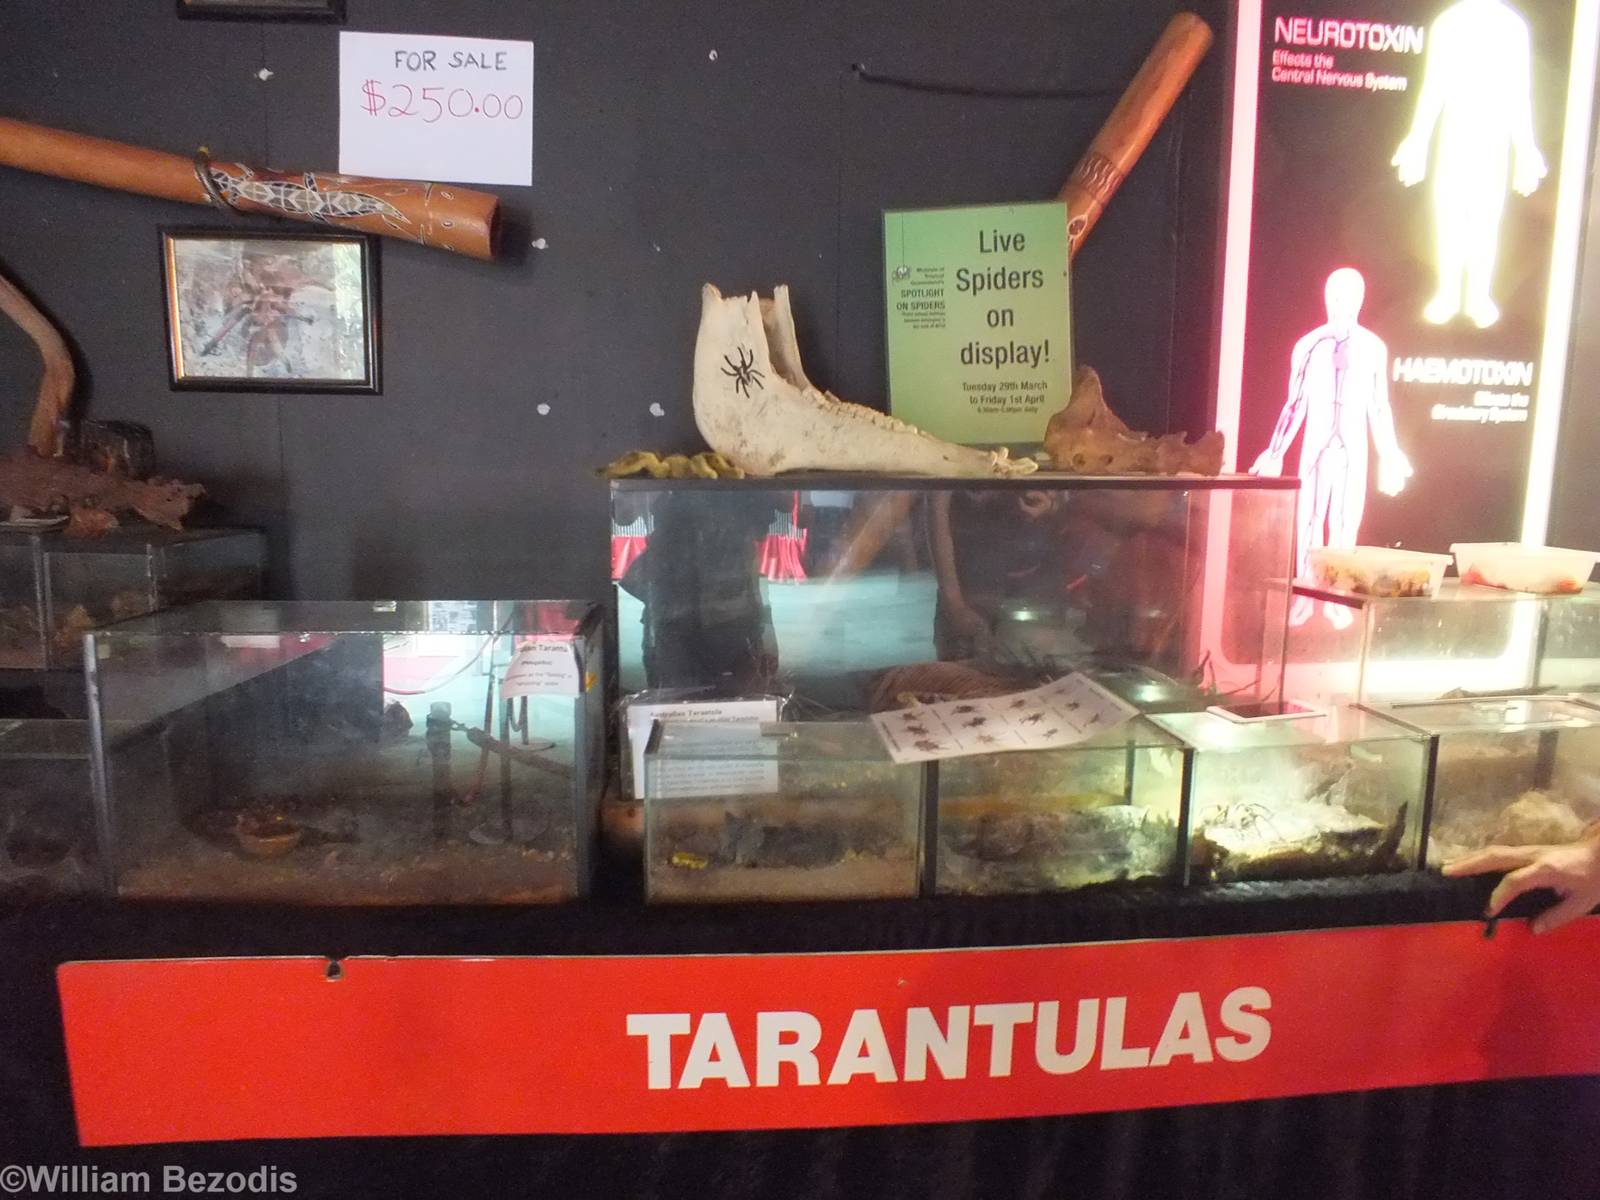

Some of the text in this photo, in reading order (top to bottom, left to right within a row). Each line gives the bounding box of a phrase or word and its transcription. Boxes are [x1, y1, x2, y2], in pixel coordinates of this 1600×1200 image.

[1274, 16, 1425, 54] NEUROTOXIN
[394, 50, 508, 71] FOR SALE
[1272, 49, 1335, 69] Effects the
[1271, 66, 1408, 92] Central Nervous System
[359, 79, 523, 123] $250.00
[979, 229, 1026, 254] Live
[900, 288, 945, 298] SPOTLIGHT
[955, 266, 1044, 297] Spiders
[896, 301, 946, 311] ON SPIDERS
[986, 308, 1015, 328] on
[960, 339, 1050, 369] display!
[1392, 356, 1534, 387] HAEMOTOXIN
[962, 380, 1048, 393] Tuesday 29th March
[969, 394, 1045, 406] to Friday 1st April
[626, 985, 1273, 1090] TARANTULAS
